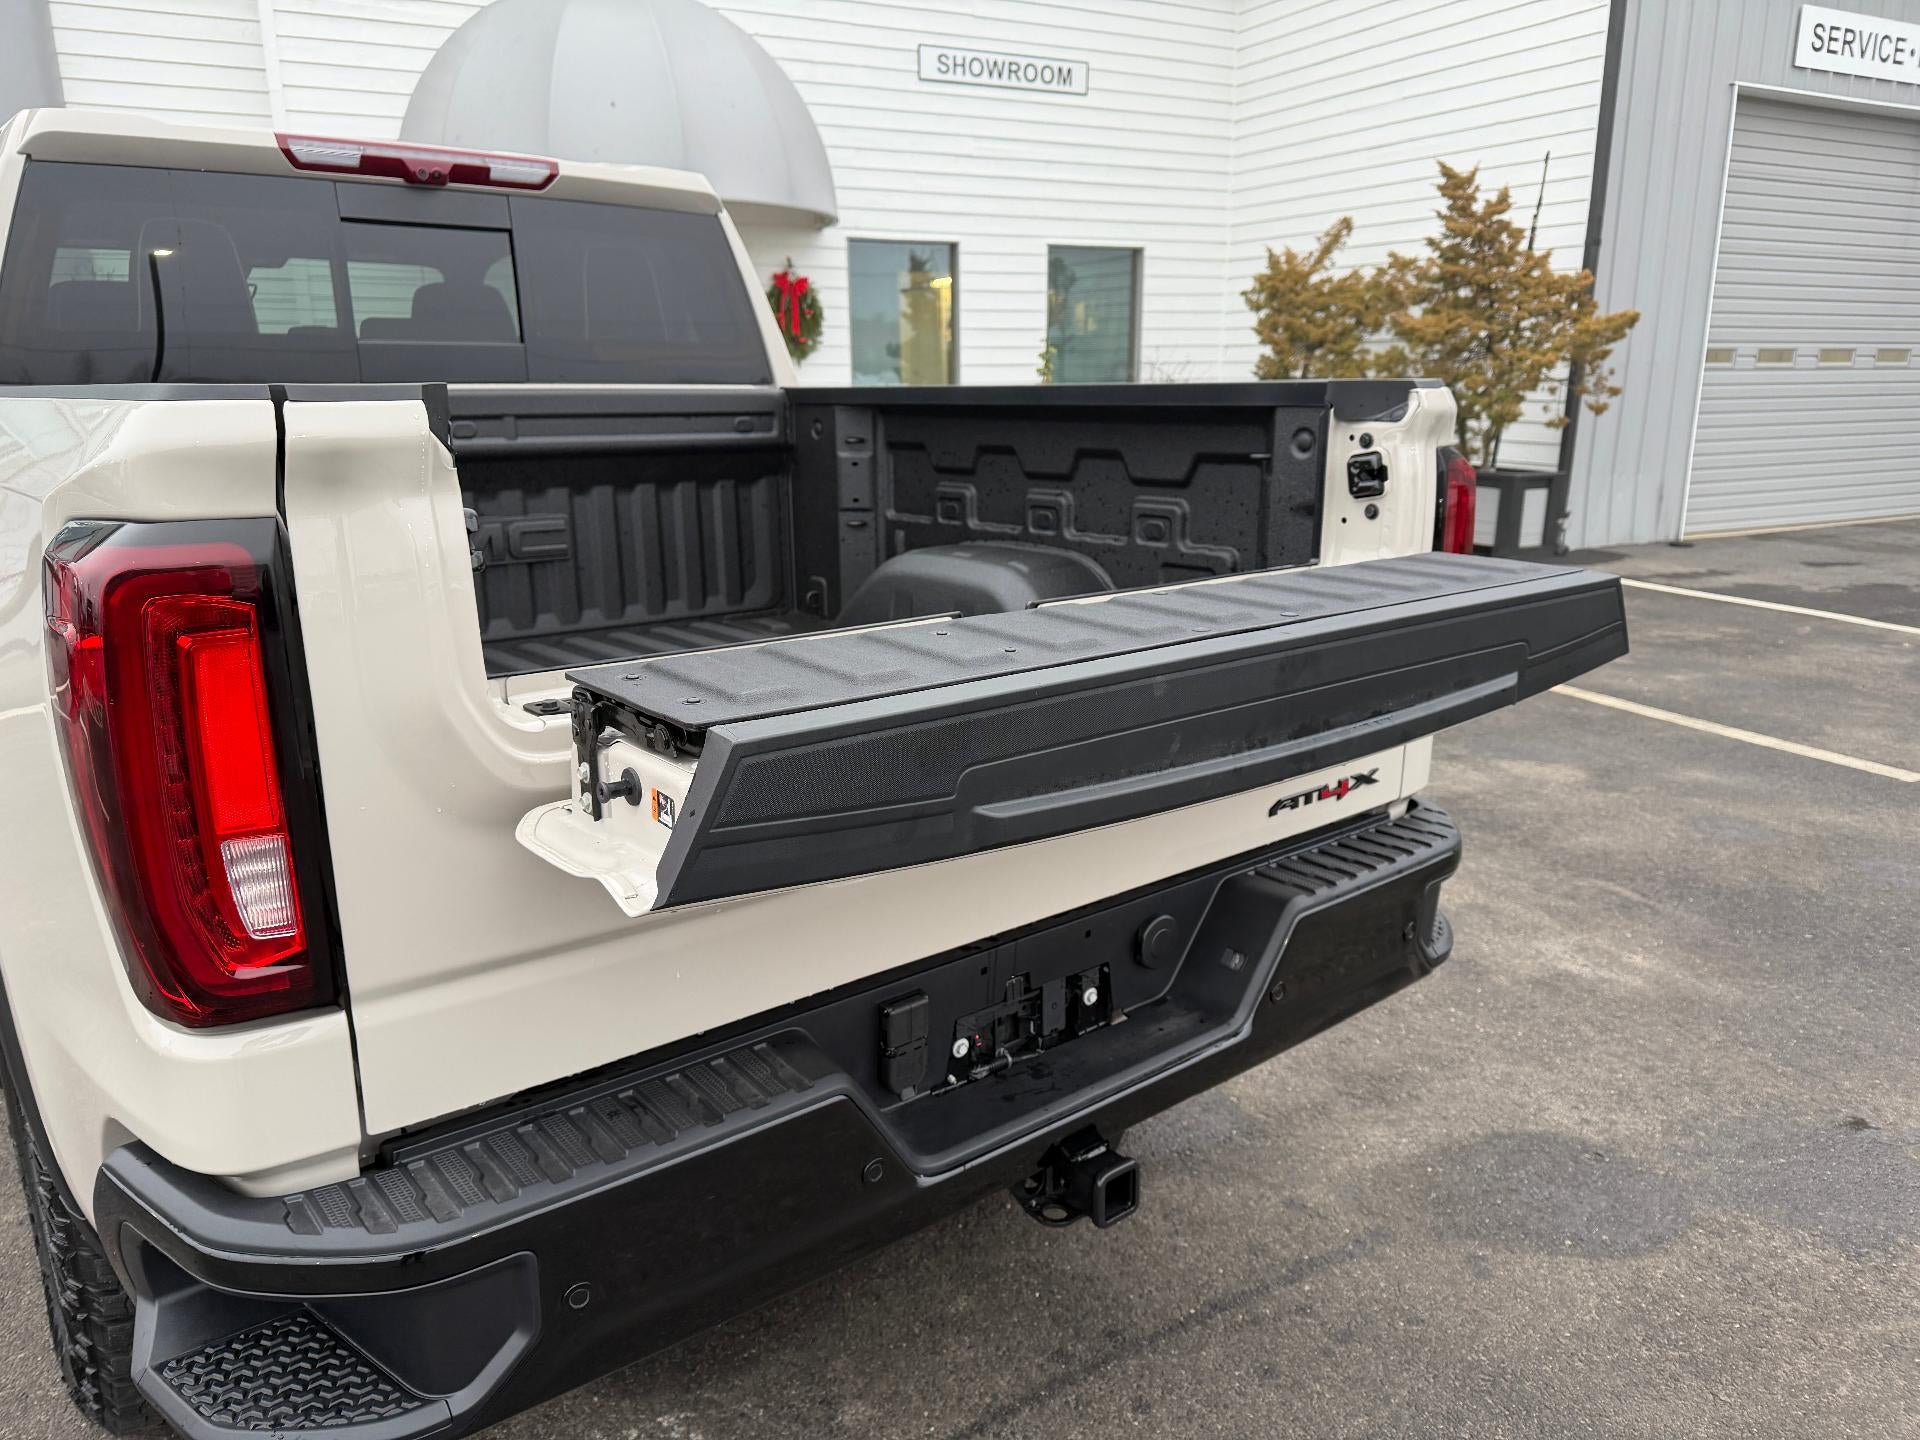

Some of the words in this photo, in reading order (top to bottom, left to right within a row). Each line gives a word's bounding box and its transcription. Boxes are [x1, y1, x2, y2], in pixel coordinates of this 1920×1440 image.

[1811, 23, 1907, 65] SERVICE
[937, 54, 1073, 86] SHOWROOM
[1268, 768, 1379, 817] AT4X
